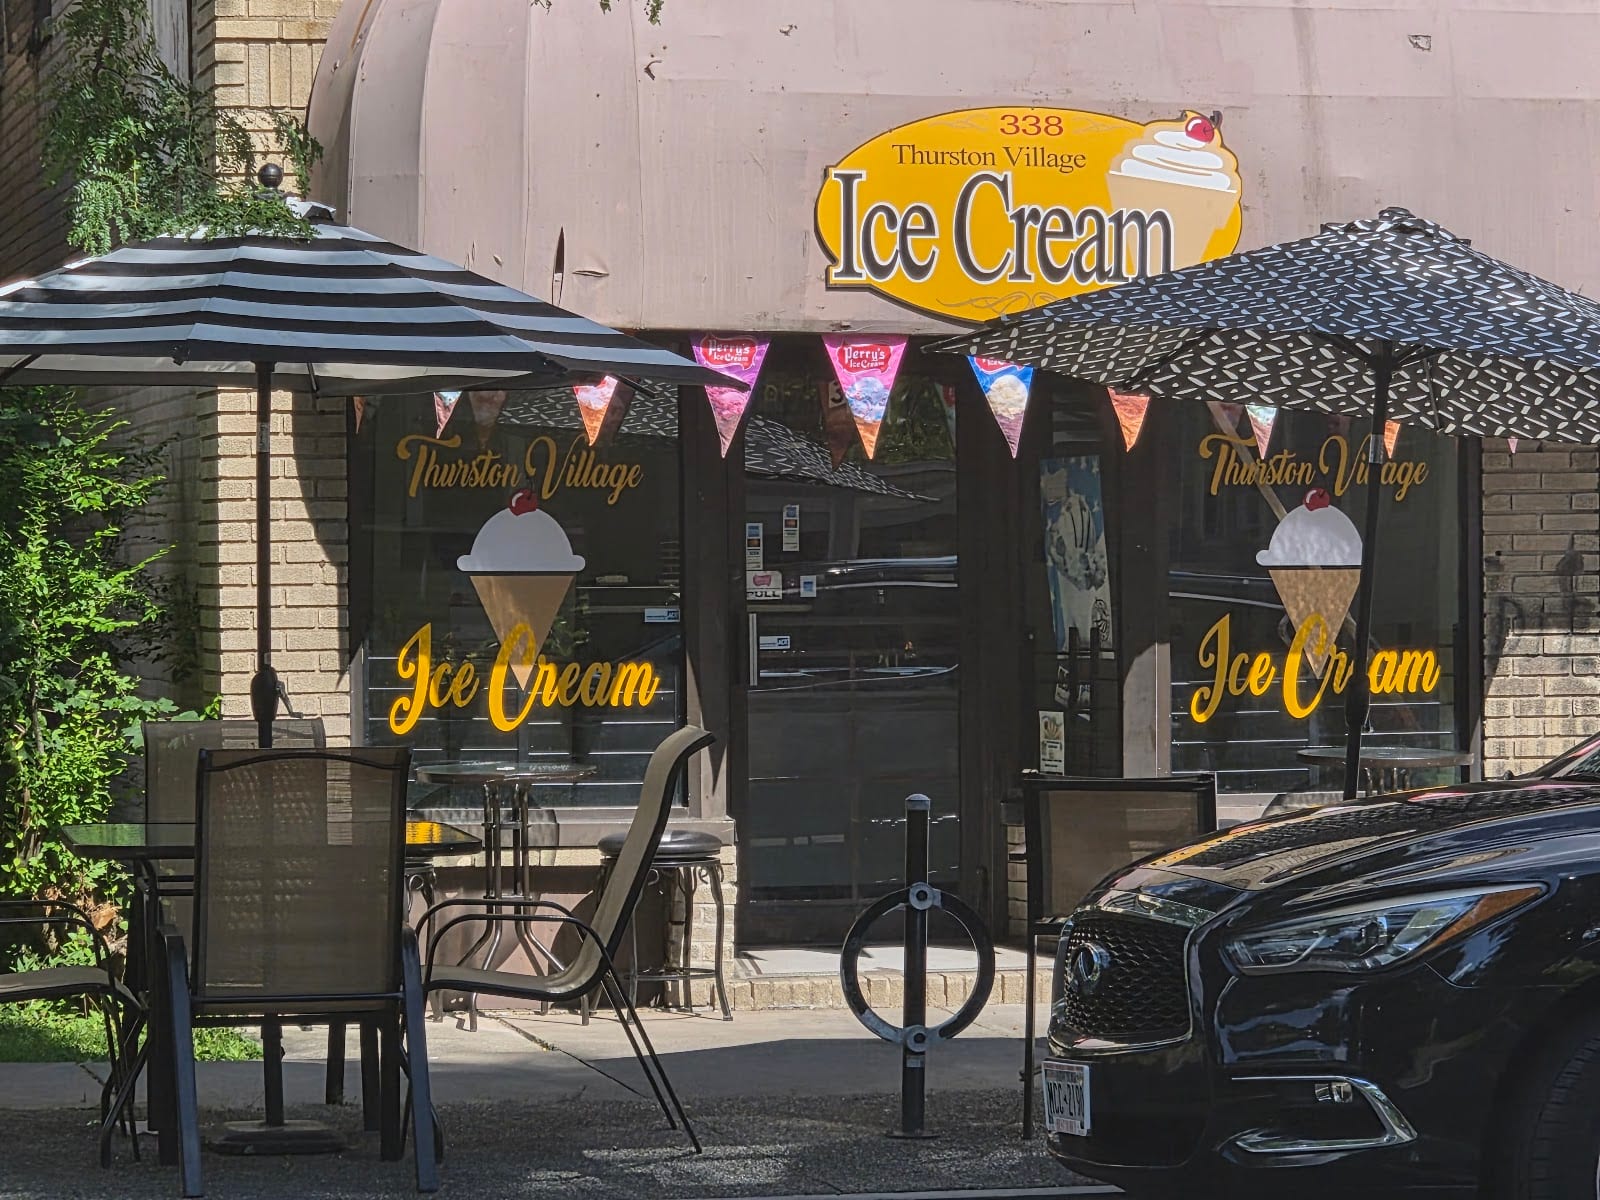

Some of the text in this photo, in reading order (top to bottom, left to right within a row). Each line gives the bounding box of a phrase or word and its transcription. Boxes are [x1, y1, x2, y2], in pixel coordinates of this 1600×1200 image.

[892, 144, 1087, 174] Thurston Village
[999, 114, 1064, 136] 338
[832, 170, 1174, 284] Ice Cream
[708, 339, 751, 357] Perry's
[844, 346, 885, 364] Perry's
[396, 434, 643, 504] Thurston Village
[1199, 433, 1429, 502] Thurston Viage
[389, 622, 660, 735] Ice Cream
[1190, 612, 1440, 723] Ice Cram
